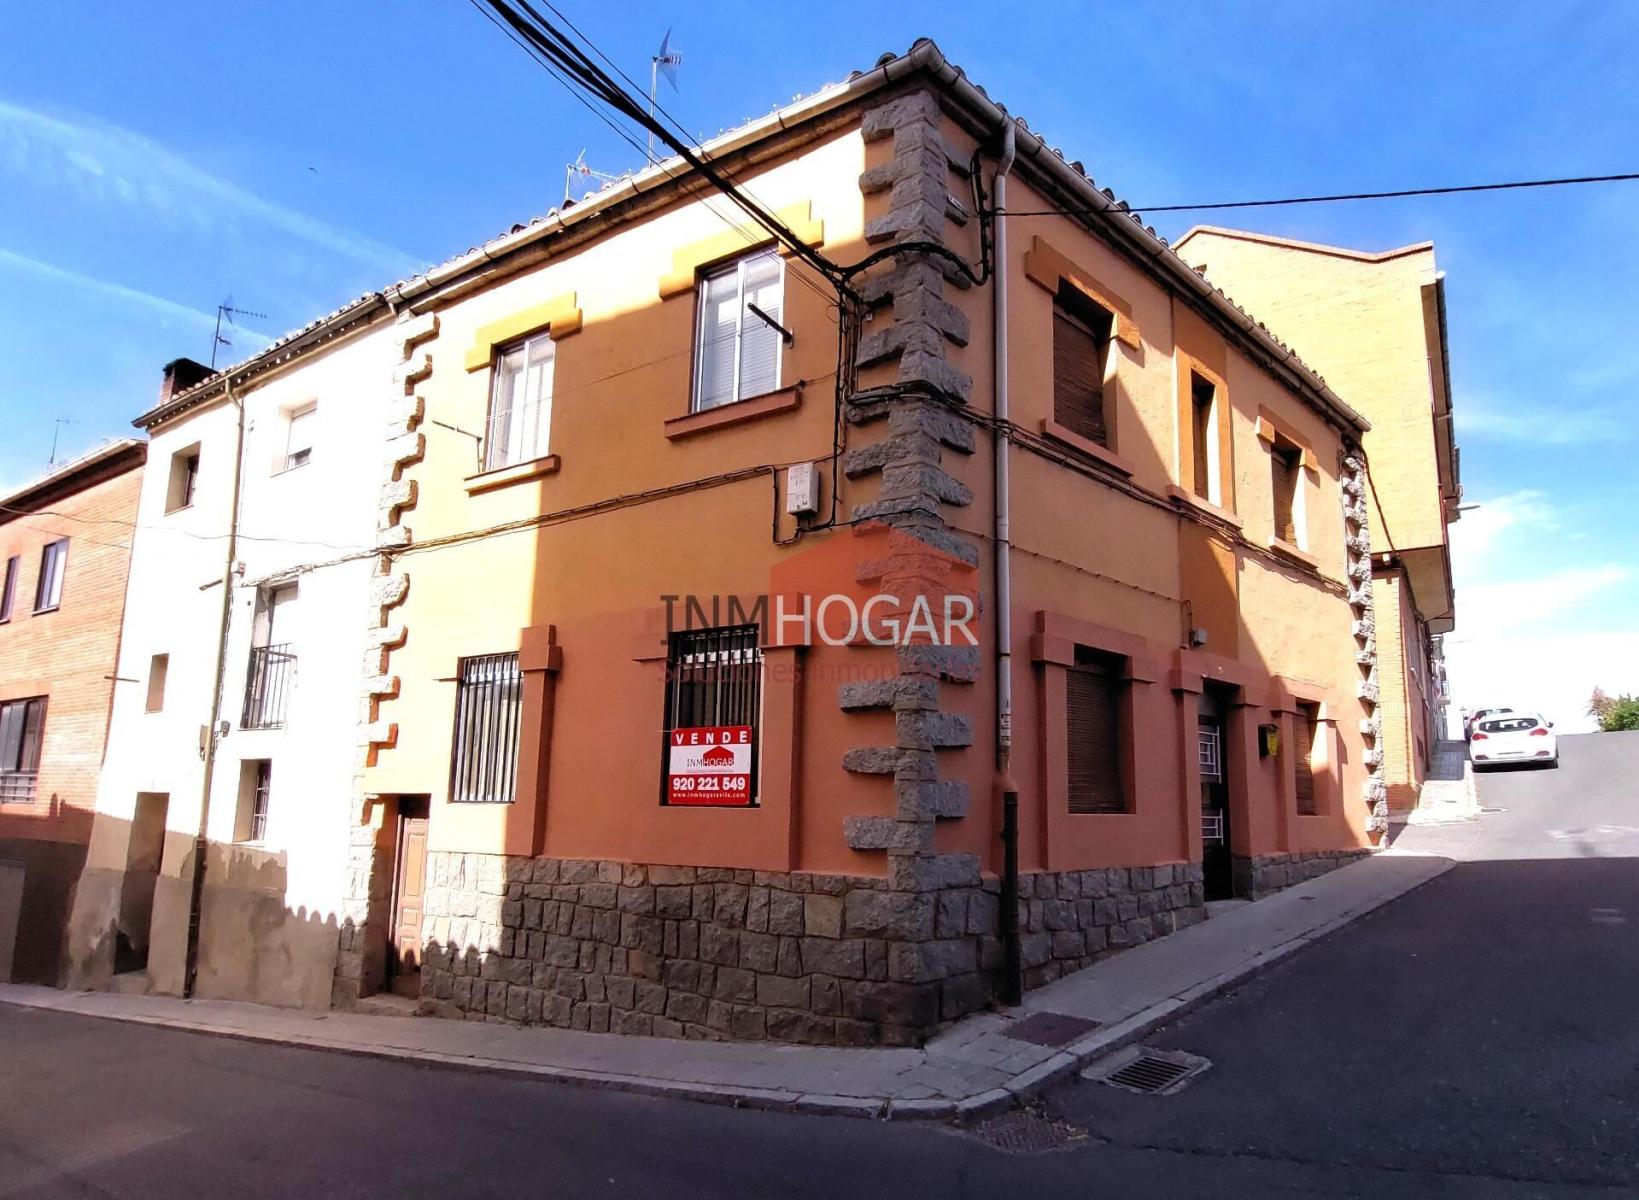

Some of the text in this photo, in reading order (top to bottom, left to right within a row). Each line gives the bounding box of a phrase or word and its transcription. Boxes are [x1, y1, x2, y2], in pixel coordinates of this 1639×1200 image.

[675, 731, 747, 745] VENDE
[686, 757, 734, 767] INMHOGAR
[673, 777, 746, 791] 920 221 549
